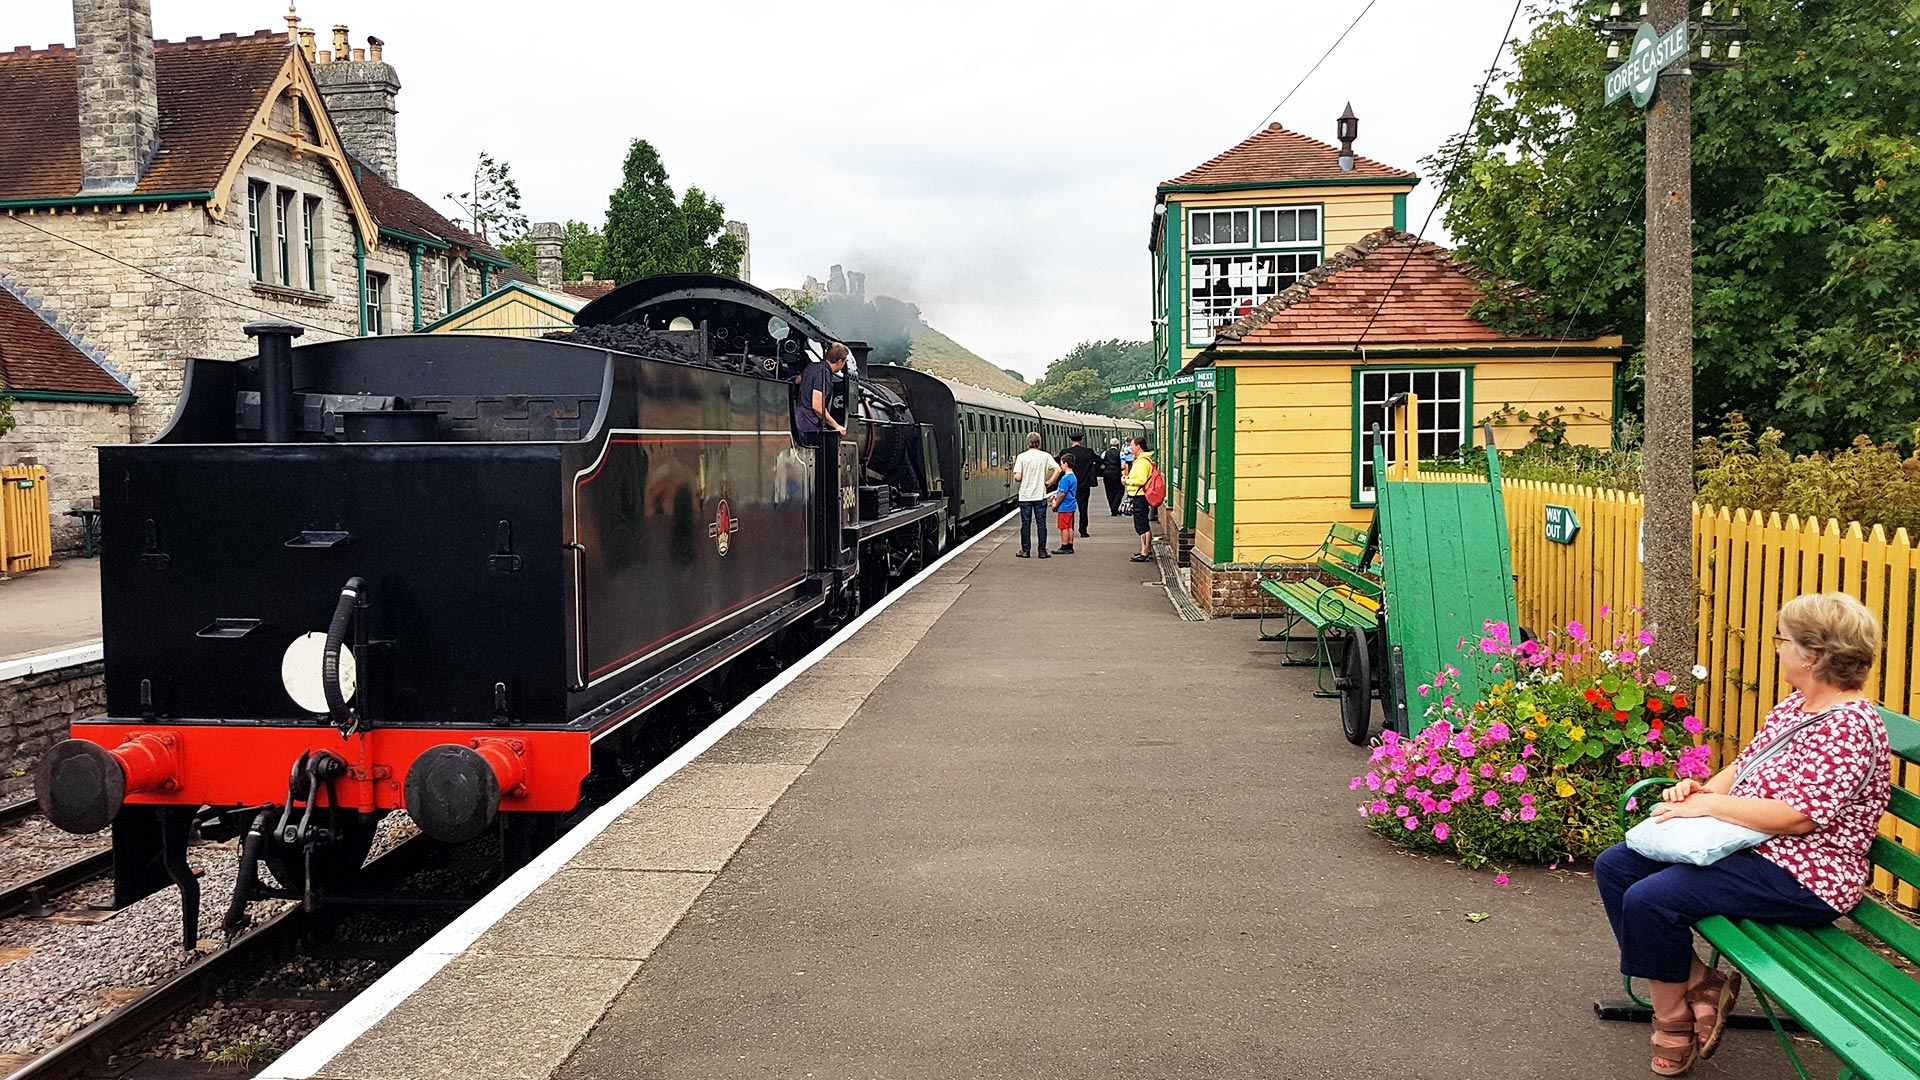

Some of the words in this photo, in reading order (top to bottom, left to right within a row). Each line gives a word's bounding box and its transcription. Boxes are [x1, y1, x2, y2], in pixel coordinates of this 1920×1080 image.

[1607, 59, 1640, 98] CORFE
[1642, 27, 1683, 74] CASTLE
[1147, 379, 1176, 389] HARMAN'S
[1177, 376, 1194, 384] CROSS
[1197, 372, 1213, 380] NEXT
[1546, 507, 1561, 523] WAY
[1546, 523, 1561, 539] OUT
